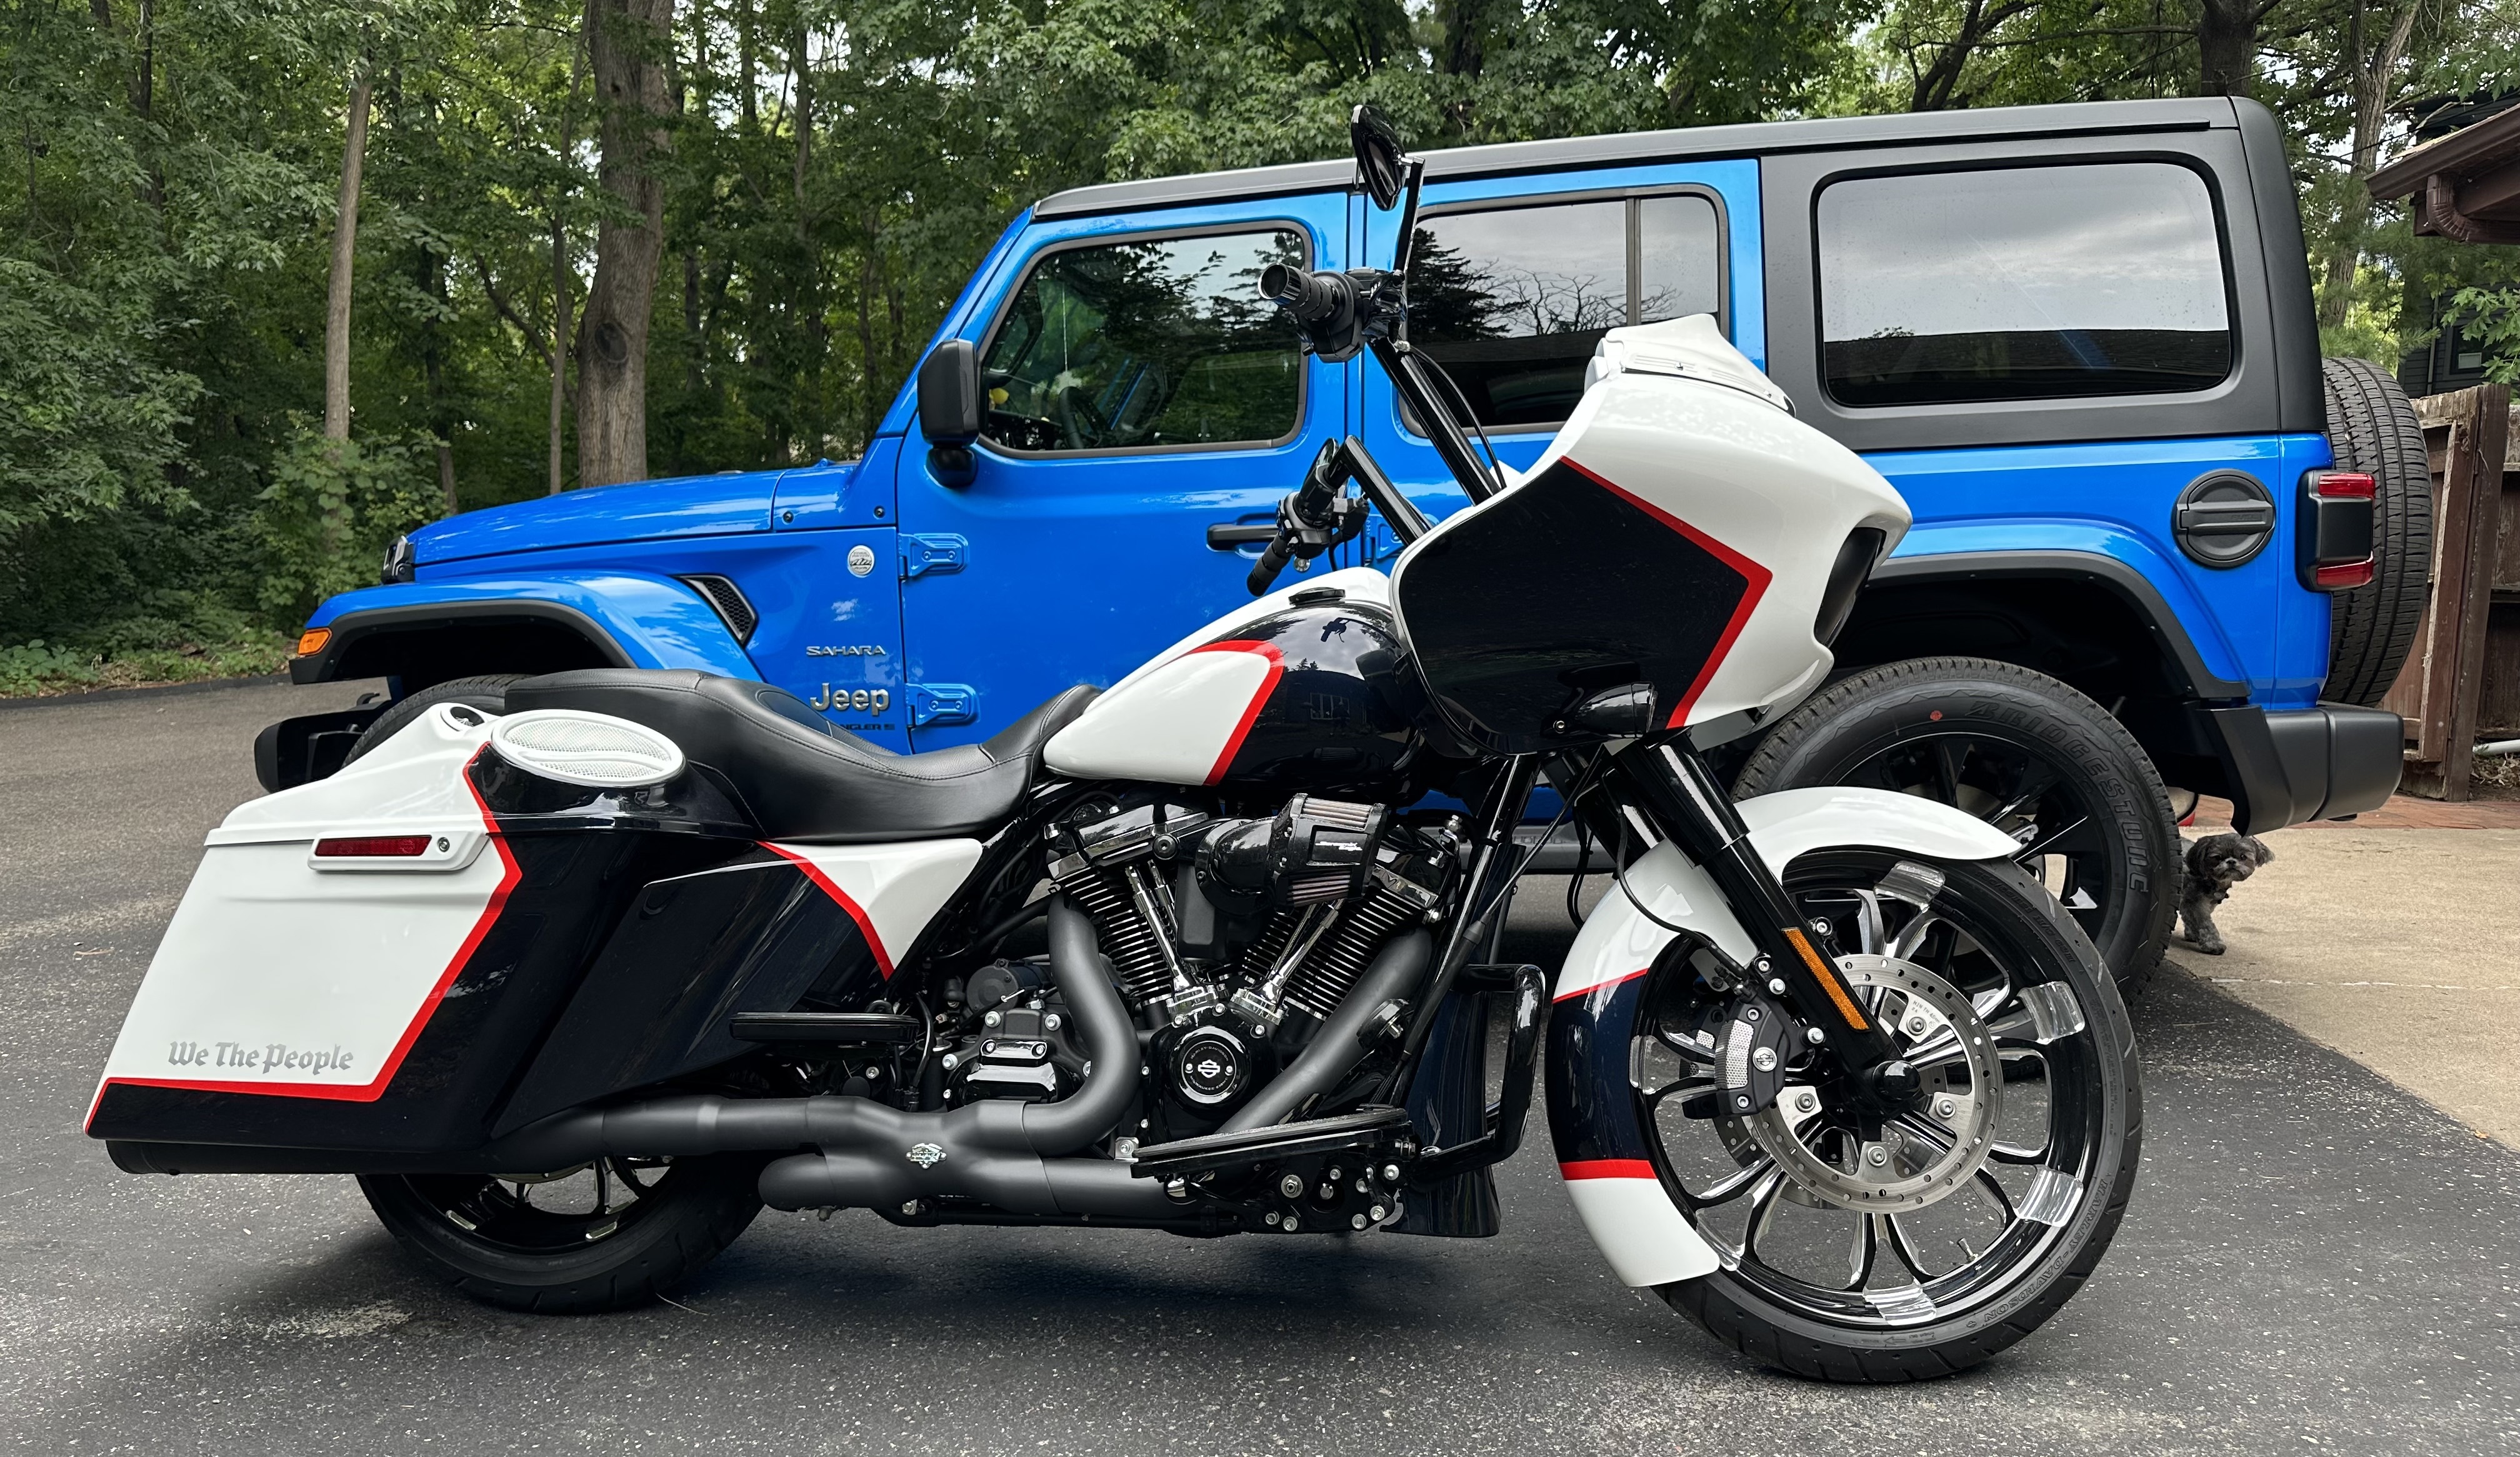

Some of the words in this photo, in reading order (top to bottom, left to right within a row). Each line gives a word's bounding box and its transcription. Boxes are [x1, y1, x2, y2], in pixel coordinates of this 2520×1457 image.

[806, 645, 886, 656] SAHARA
[809, 682, 890, 716] Jeep
[1964, 700, 2150, 893] BRIDGESTONE
[168, 1041, 209, 1067] We
[215, 1041, 260, 1068] The
[262, 1043, 354, 1076] People
[1984, 1178, 2108, 1323] HARLEY-DAVIDSON
